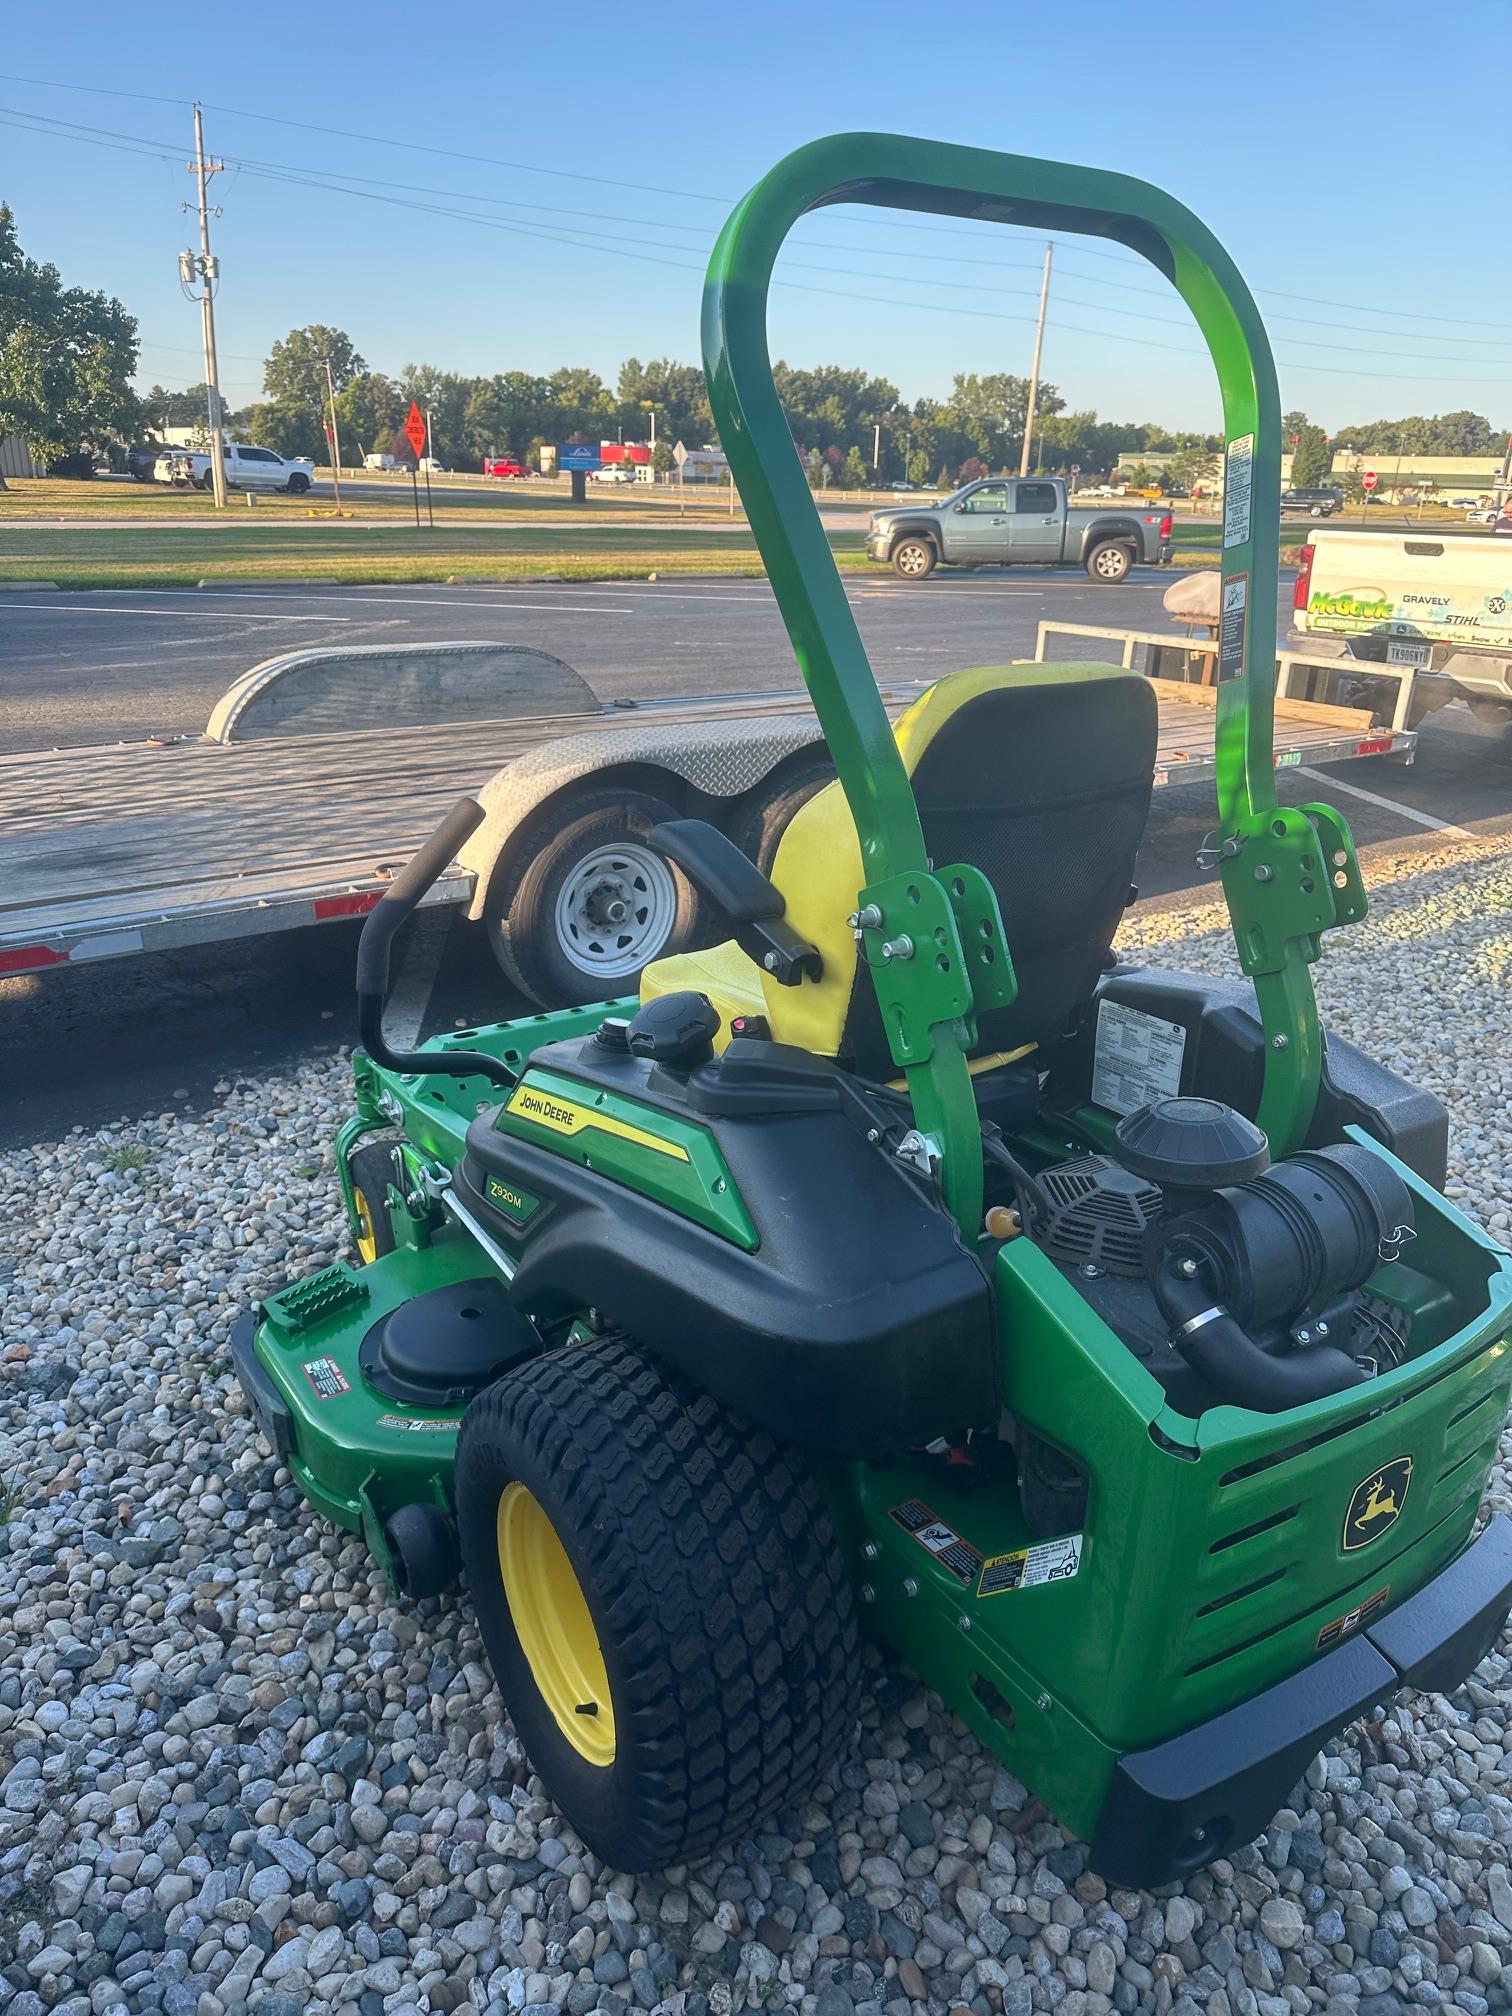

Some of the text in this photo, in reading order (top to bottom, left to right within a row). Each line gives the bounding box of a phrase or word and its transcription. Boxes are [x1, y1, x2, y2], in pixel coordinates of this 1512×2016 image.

[1402, 595, 1451, 606] GRAVELY
[1316, 618, 1356, 631] OUTDOOR
[1443, 615, 1481, 626] STIHL
[519, 1093, 575, 1126] JOHN DEERE
[490, 1181, 522, 1209] Z920M
